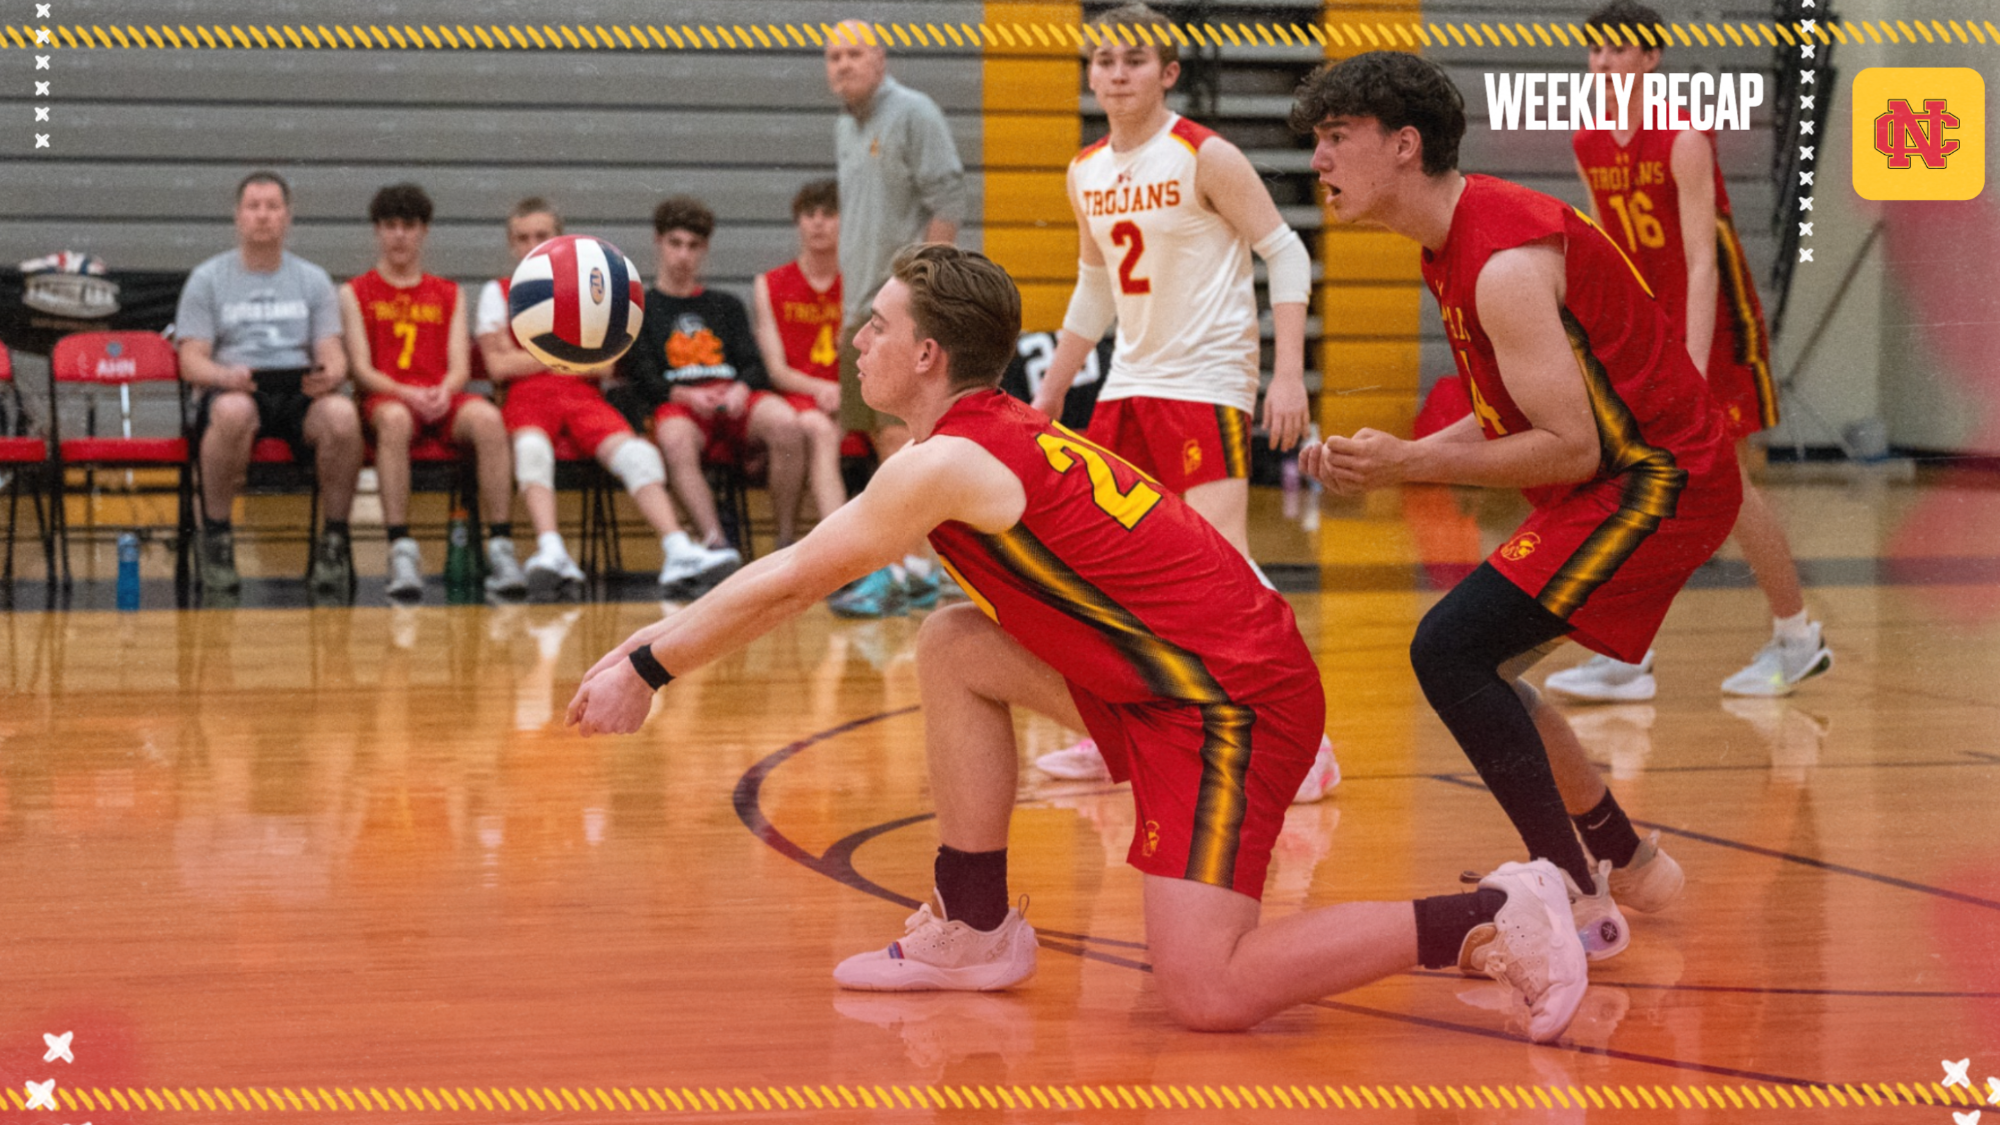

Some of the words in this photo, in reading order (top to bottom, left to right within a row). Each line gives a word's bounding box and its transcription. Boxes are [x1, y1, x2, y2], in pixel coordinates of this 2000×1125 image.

[1083, 179, 1181, 216] TROJANS
[1608, 190, 1666, 253] 16
[1110, 219, 1152, 296] 2
[393, 320, 418, 370] 7
[809, 323, 837, 367] 4
[1035, 419, 1165, 533] 2
